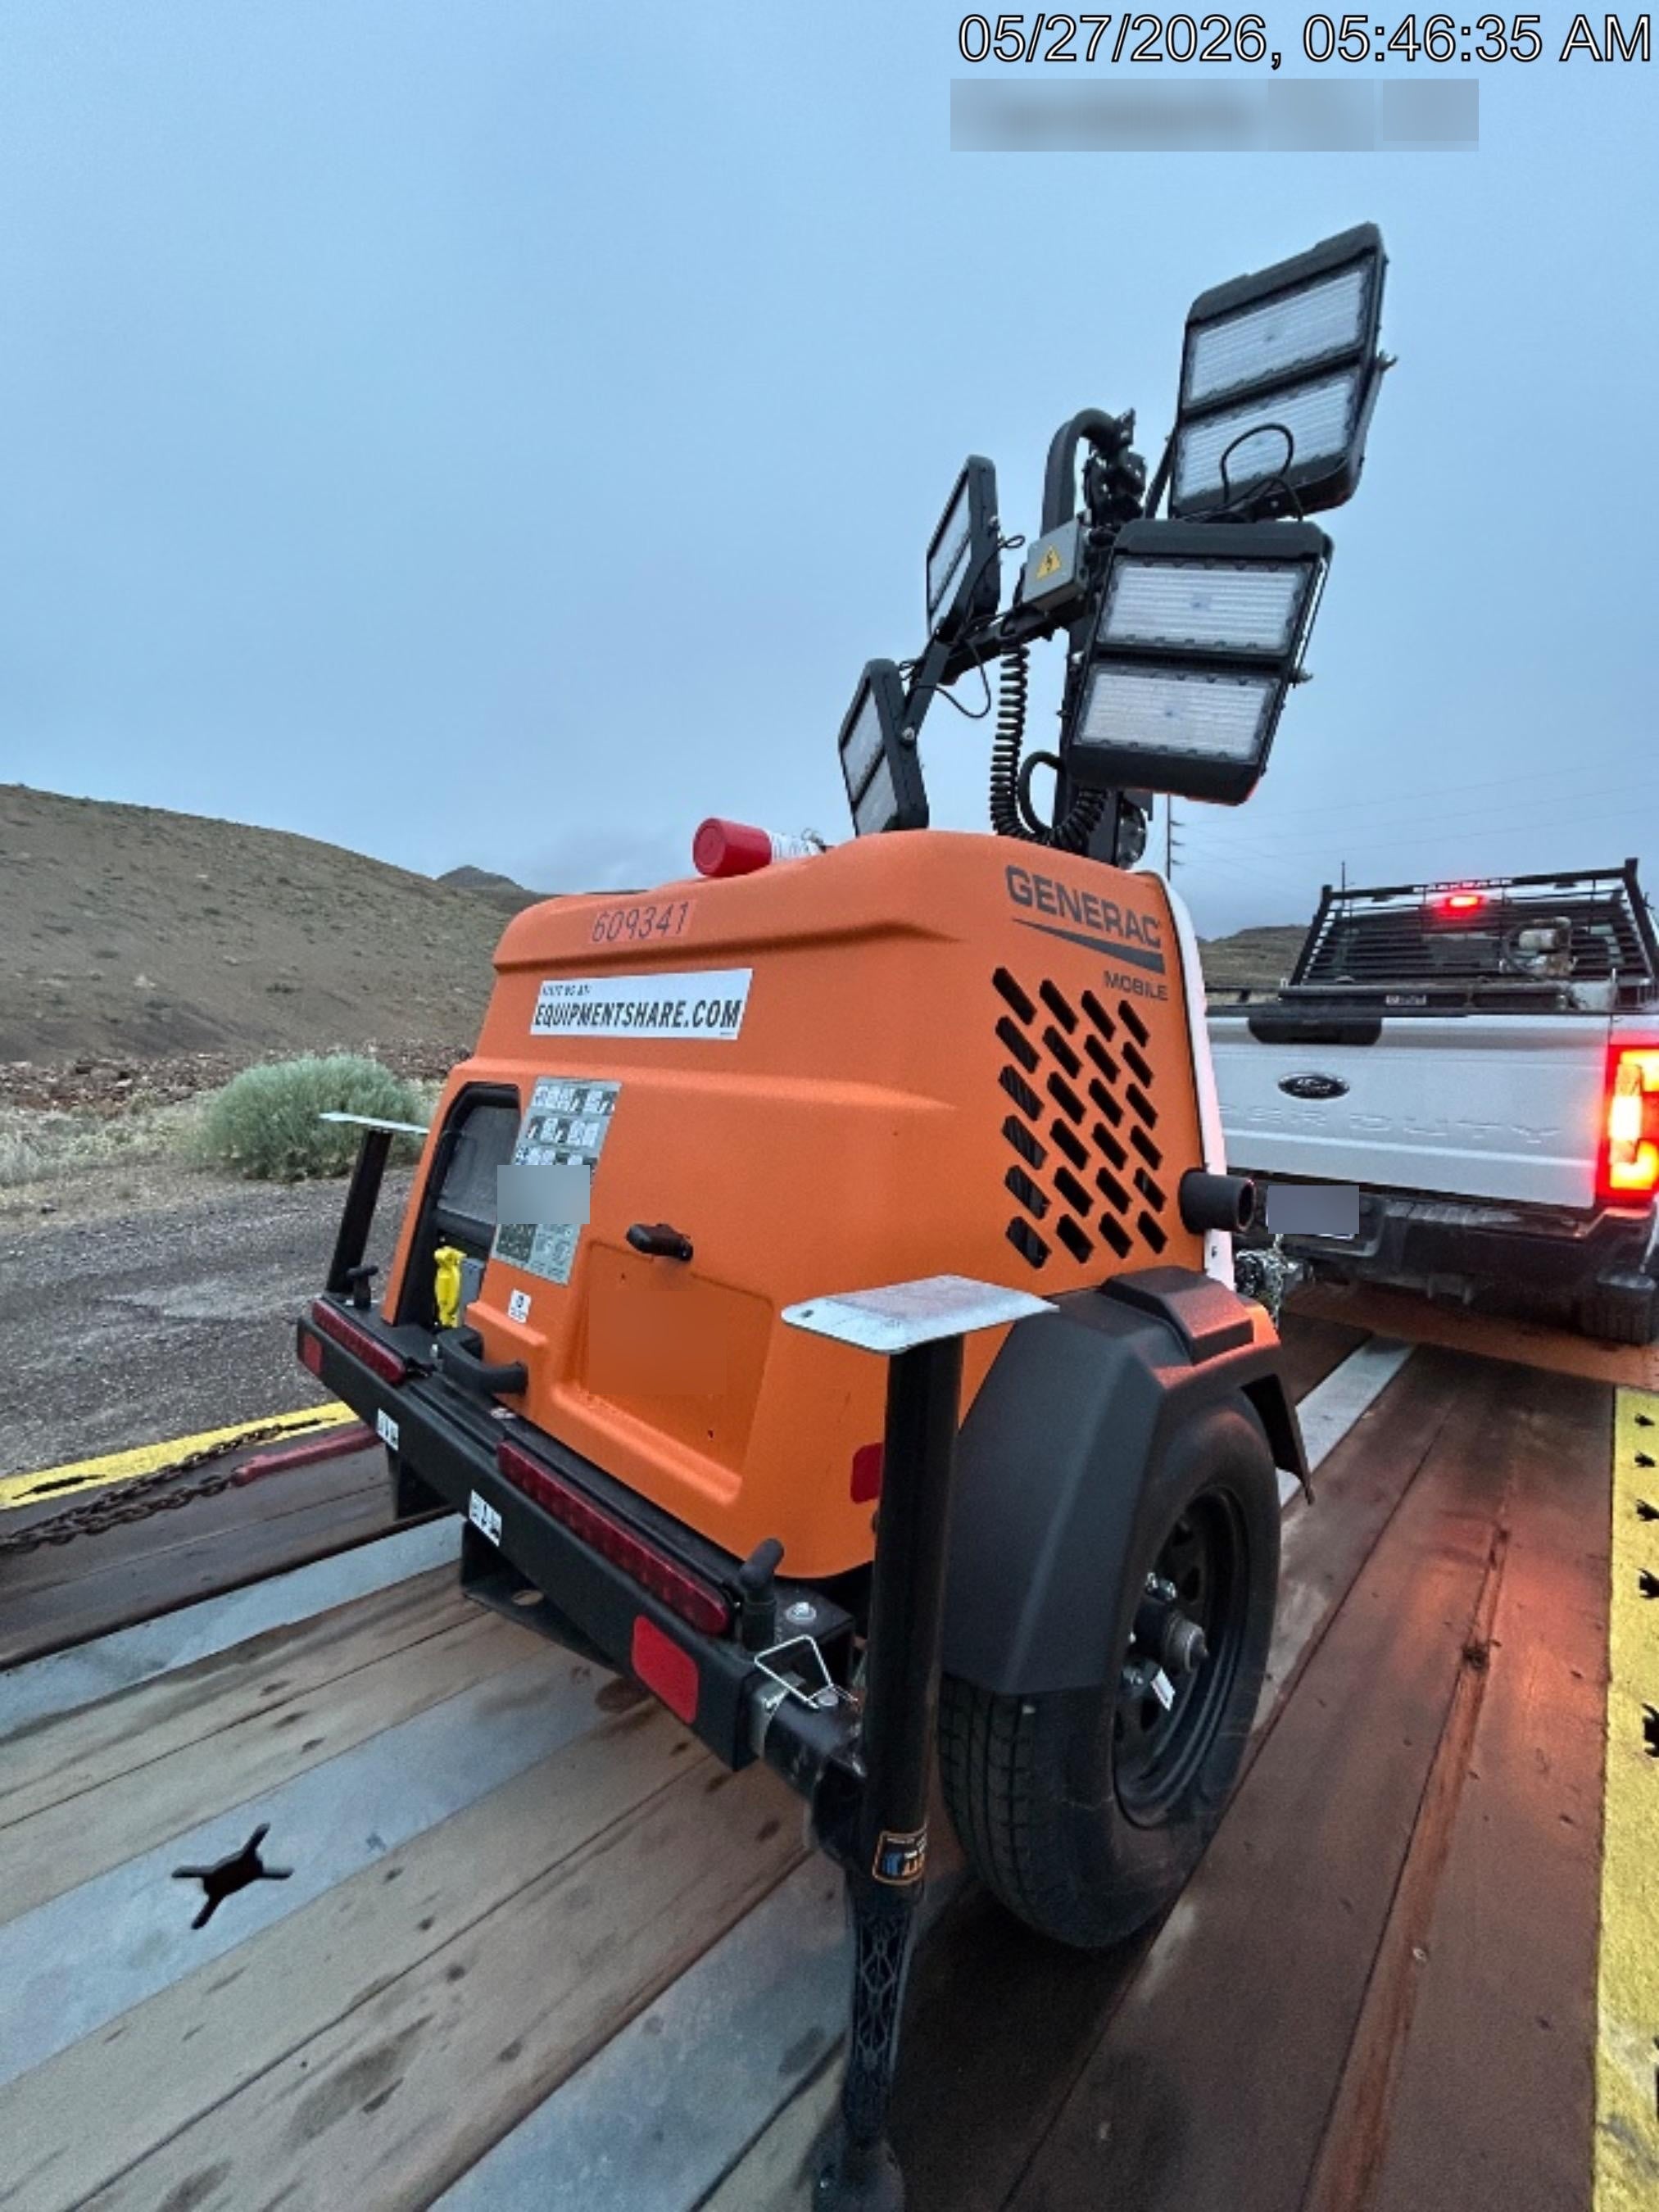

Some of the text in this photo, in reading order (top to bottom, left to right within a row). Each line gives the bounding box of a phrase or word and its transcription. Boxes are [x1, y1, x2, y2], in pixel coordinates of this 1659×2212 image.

[592, 900, 690, 943] 609341
[1005, 864, 1161, 949] GENERAC
[1103, 970, 1169, 1000] MOBILE
[534, 999, 742, 1029] EQUIPMENTSHARE.COM
